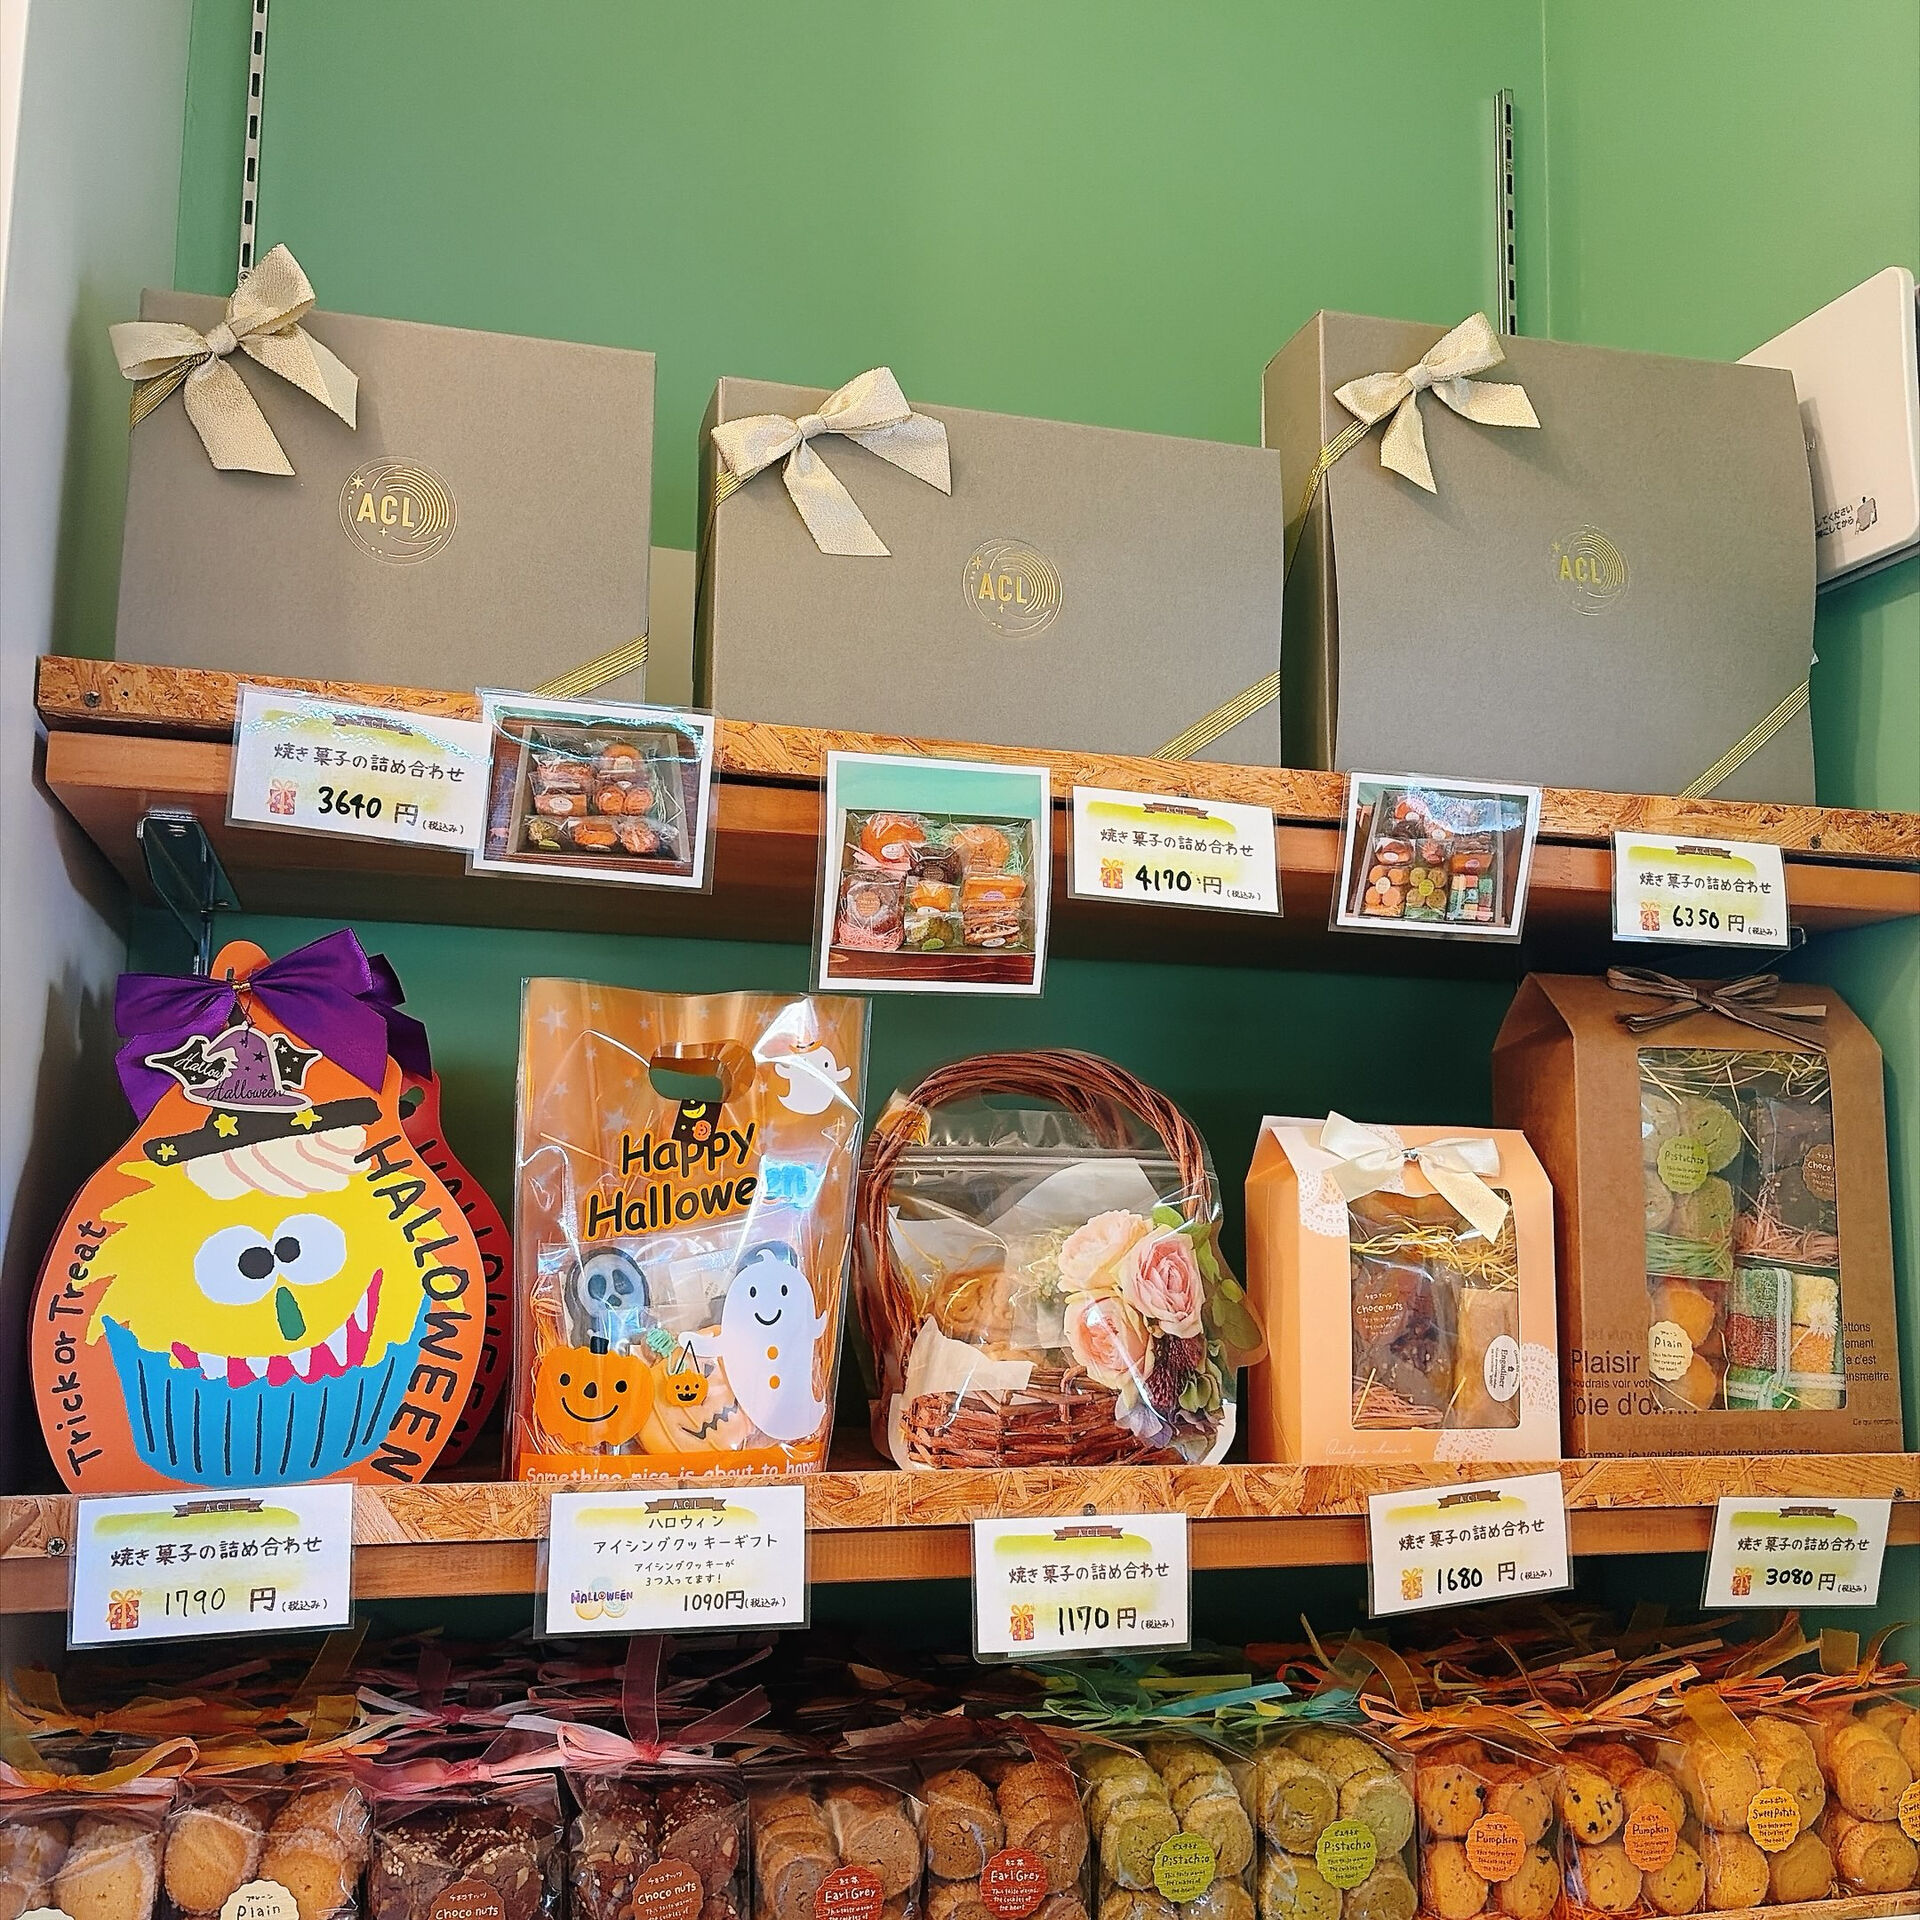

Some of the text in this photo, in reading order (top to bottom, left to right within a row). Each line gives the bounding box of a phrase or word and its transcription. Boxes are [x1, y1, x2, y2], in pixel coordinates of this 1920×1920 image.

[356, 493, 414, 527] ACL
[1560, 555, 1601, 584] ACL
[979, 573, 1027, 603] ACL
[273, 742, 465, 782] 焼き菓子の詰め合わせ
[317, 786, 382, 819] 3640
[1100, 828, 1254, 857] 焼き菓子の詰め合わせ
[1135, 864, 1192, 891] 4170
[1639, 872, 1772, 895] 焼き菓子の詰め合わせ
[1672, 905, 1720, 930] 6350
[621, 1123, 756, 1178] Happy
[354, 1135, 472, 1484] HALLOWEEN
[49, 1221, 107, 1477] Trick or Treat
[1571, 1349, 1641, 1374] Plaisir
[649, 1515, 724, 1530] ハロウィン
[1399, 1519, 1545, 1551] 焼き菓子の詰め合わせ
[110, 1535, 322, 1567] 焼き菓子の詰め合わせ
[593, 1534, 778, 1555] アイシングクッキーギフト
[1737, 1536, 1870, 1551] 焼き菓子の詰め合わせ
[1009, 1561, 1170, 1584] 焼き菓子の詰め合わせ
[1437, 1567, 1482, 1594] 1680
[1765, 1568, 1813, 1585] 3080
[165, 1588, 226, 1617] 1790
[570, 1590, 633, 1604] HALLOWEEN
[1058, 1606, 1109, 1636] 1170
[1476, 1830, 1518, 1845] Pumpkin
[1632, 1823, 1669, 1837] Pumpkin
[1324, 1838, 1371, 1853] Pistachio
[1162, 1853, 1210, 1867] Pistachio
[637, 1881, 697, 1905] Choco nuts
[436, 1906, 499, 1920] Choco nuts
